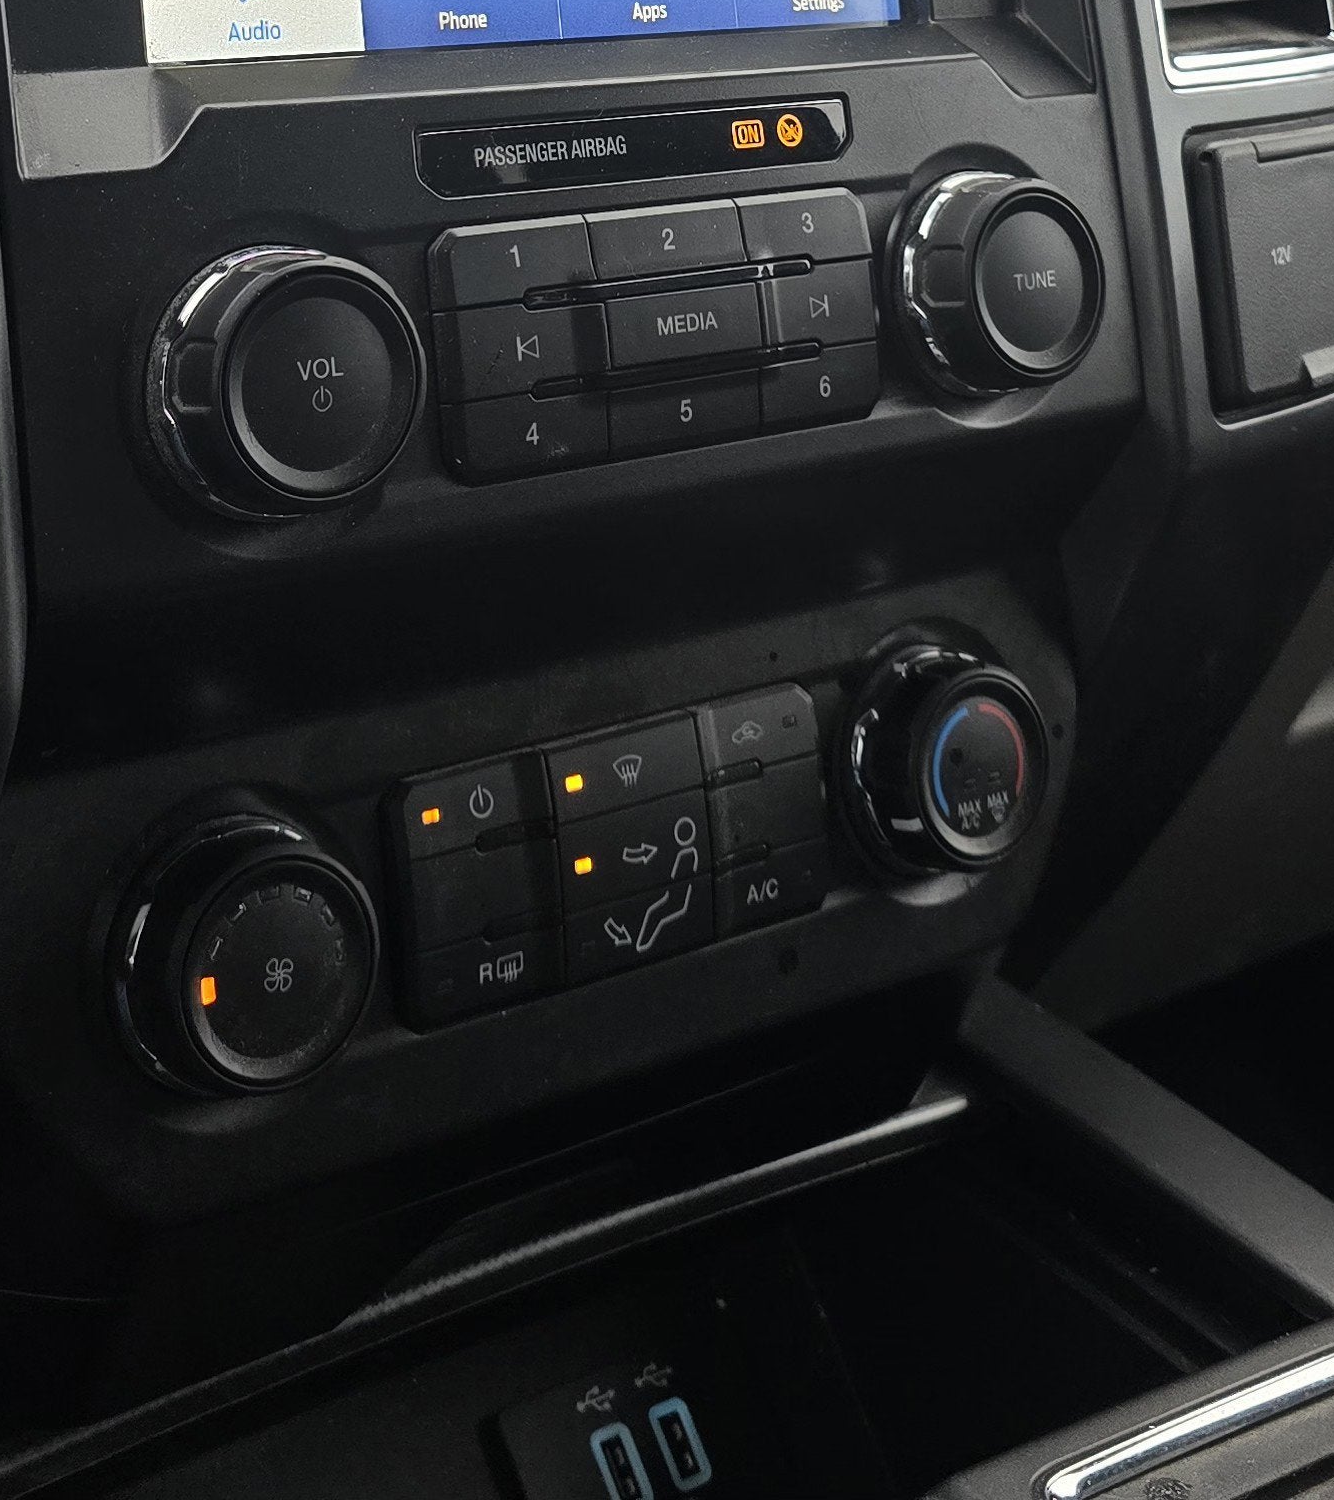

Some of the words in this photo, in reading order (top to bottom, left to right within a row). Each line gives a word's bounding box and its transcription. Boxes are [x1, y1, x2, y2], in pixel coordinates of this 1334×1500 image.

[437, 8, 488, 31] Phone
[632, 0, 668, 24] Apps
[228, 19, 281, 43] Audio
[737, 124, 760, 144] ON
[473, 139, 569, 169] PASSENGER
[571, 134, 627, 160] AIRBAG
[801, 211, 815, 235] 3
[661, 228, 676, 252] 2
[509, 245, 522, 269] 1
[1271, 245, 1292, 265] 12V
[1012, 269, 1057, 292] TUNE
[657, 311, 719, 336] MEDIA
[297, 357, 344, 382] VOL
[819, 375, 832, 399] 6
[679, 399, 693, 423] 5
[525, 422, 540, 447] 4
[747, 878, 779, 906] A/C
[479, 963, 493, 984] R
